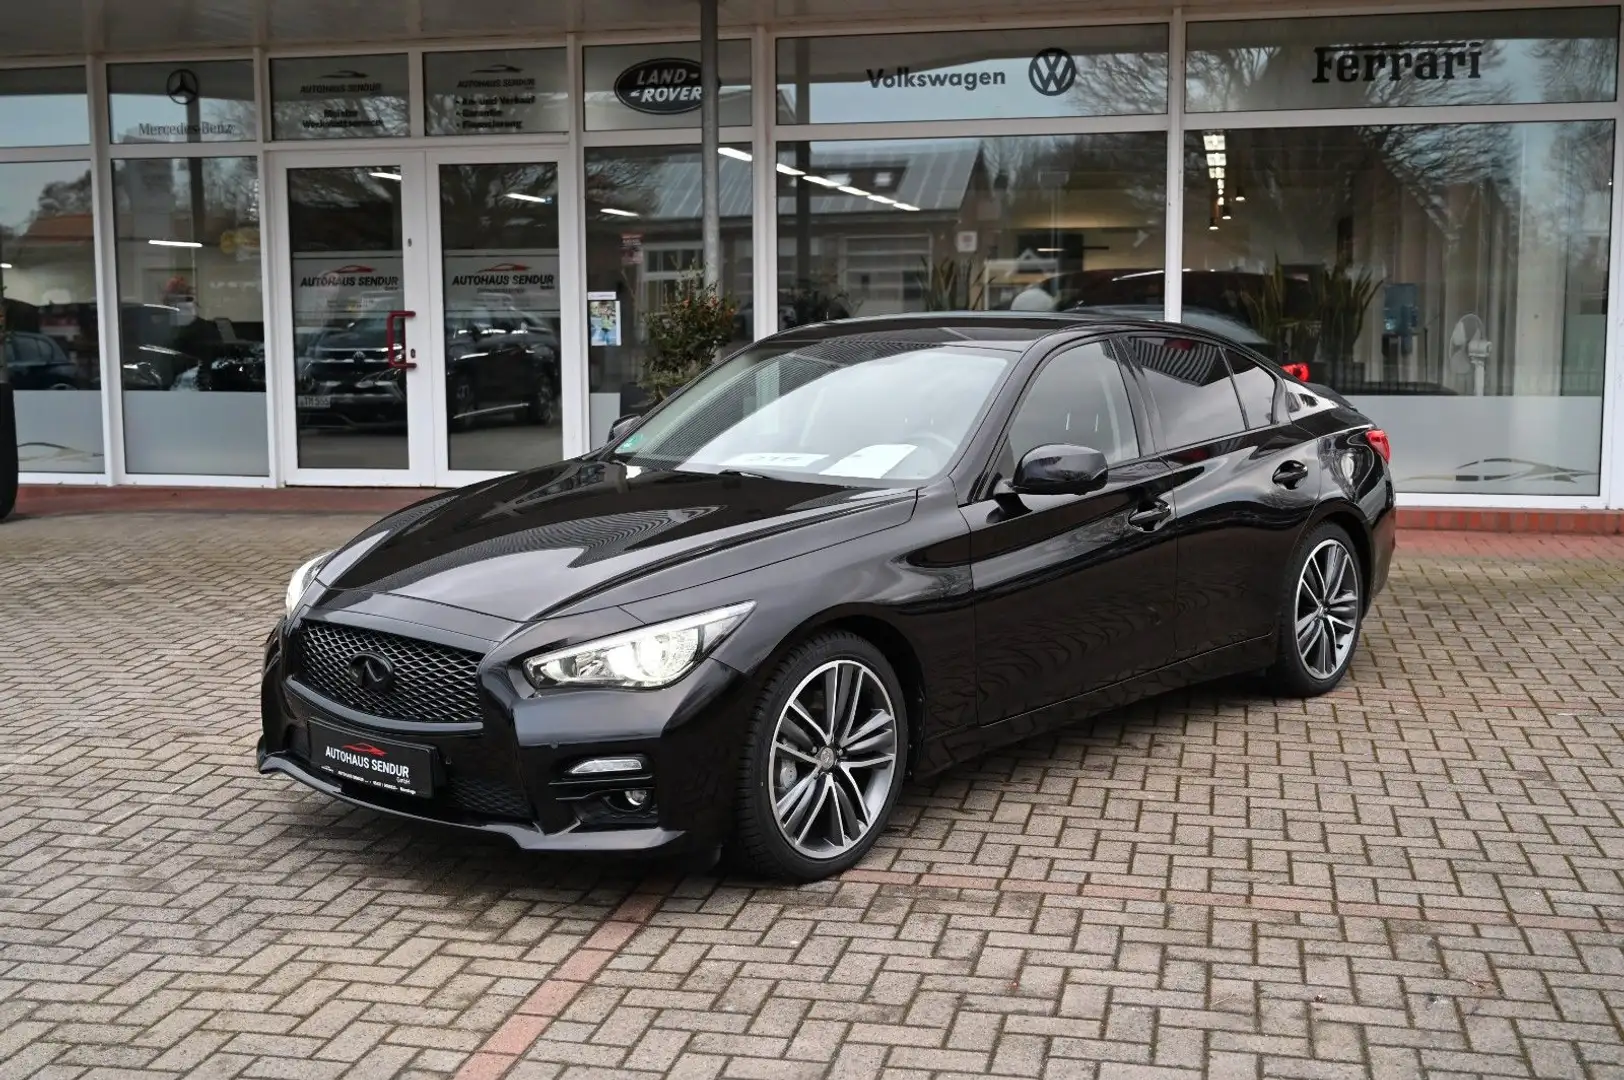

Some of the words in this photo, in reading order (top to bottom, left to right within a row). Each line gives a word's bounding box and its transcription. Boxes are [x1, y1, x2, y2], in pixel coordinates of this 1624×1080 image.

[1312, 42, 1483, 83] Ferrari
[866, 67, 1006, 91] Volkswagen
[139, 121, 235, 136] Mercedes-Benz
[300, 276, 356, 287] AUTOHAUS
[358, 275, 399, 287] SENDUR
[452, 275, 510, 286] AUTOHAUS
[512, 274, 554, 285] SENDUR
[325, 746, 370, 769] AUTOHAUS
[371, 759, 410, 778] SENDUR
